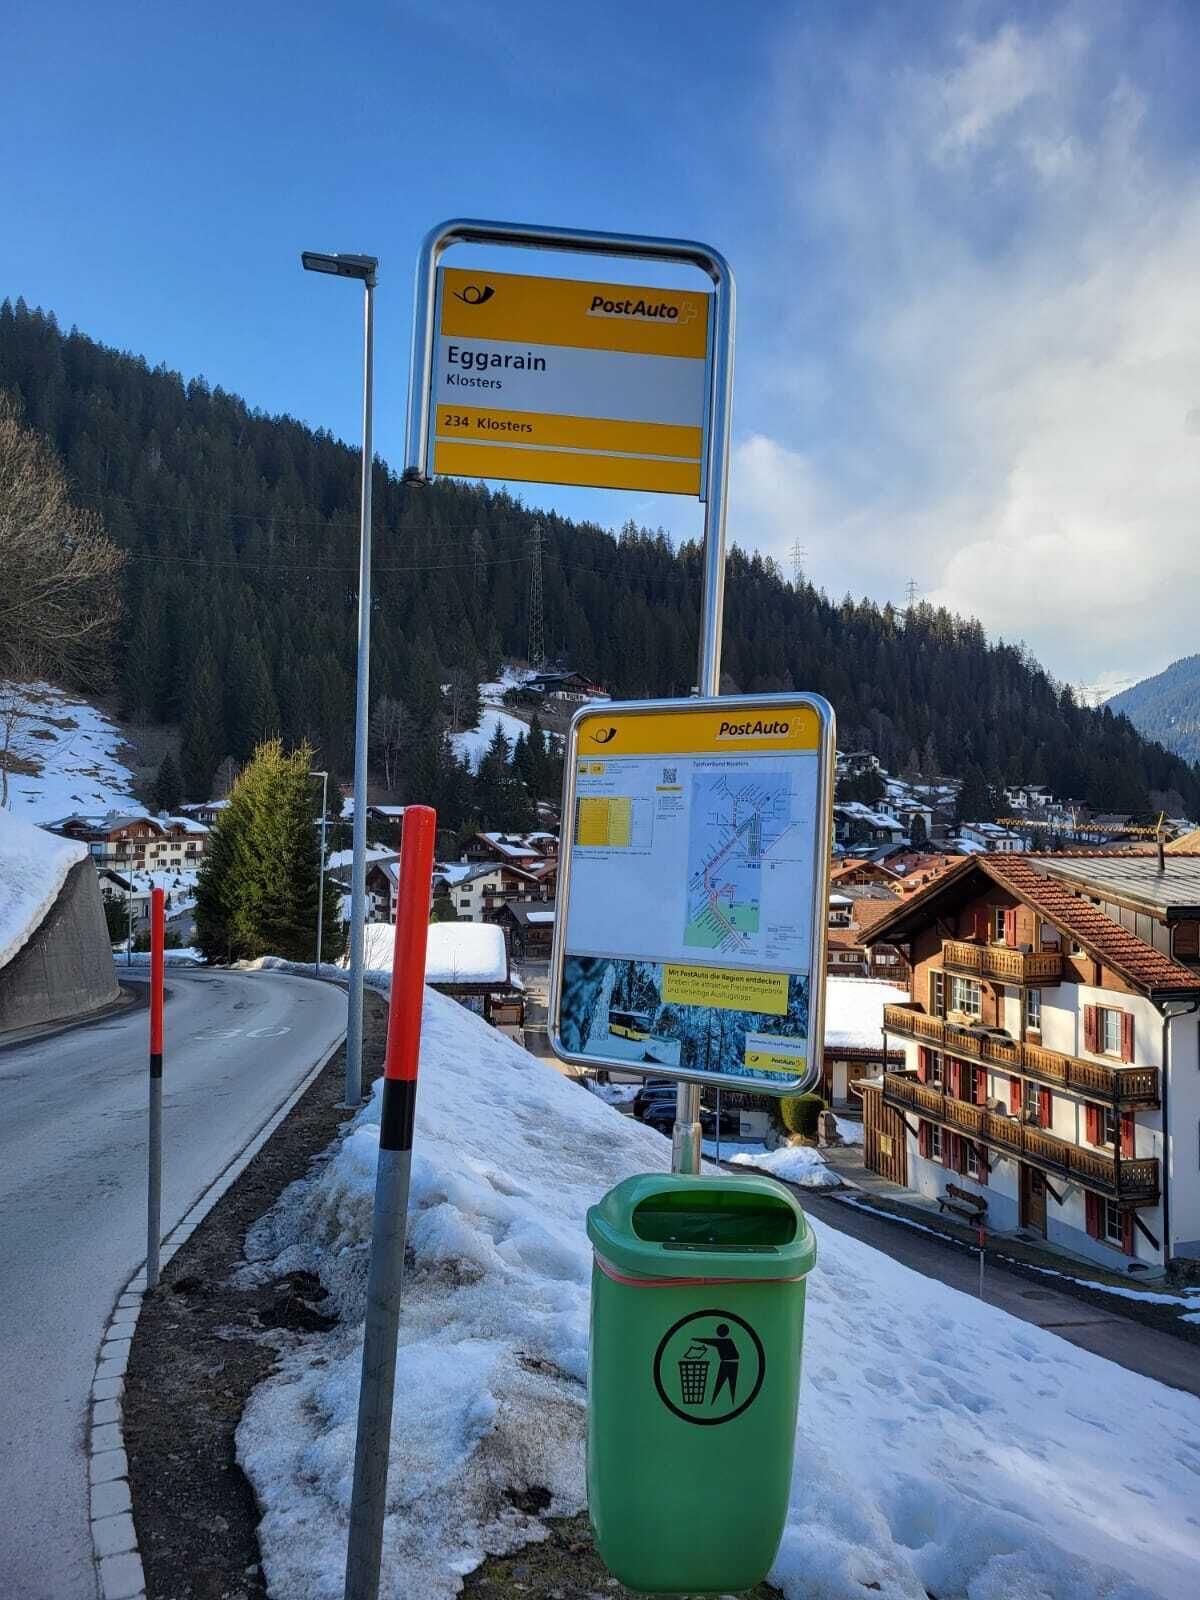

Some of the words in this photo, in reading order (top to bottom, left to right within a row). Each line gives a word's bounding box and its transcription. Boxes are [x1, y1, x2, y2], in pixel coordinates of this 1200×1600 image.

[590, 296, 678, 319] PostAuto
[447, 345, 547, 371] Eggarain
[446, 373, 503, 389] Klosters
[444, 414, 470, 427] 234
[477, 417, 533, 433] Klosters
[719, 720, 790, 736] PostAuto
[668, 968, 679, 977] Mit
[680, 970, 709, 980] PostAuto
[710, 972, 721, 980] die
[722, 974, 745, 984] Region
[746, 976, 782, 987] entdecken
